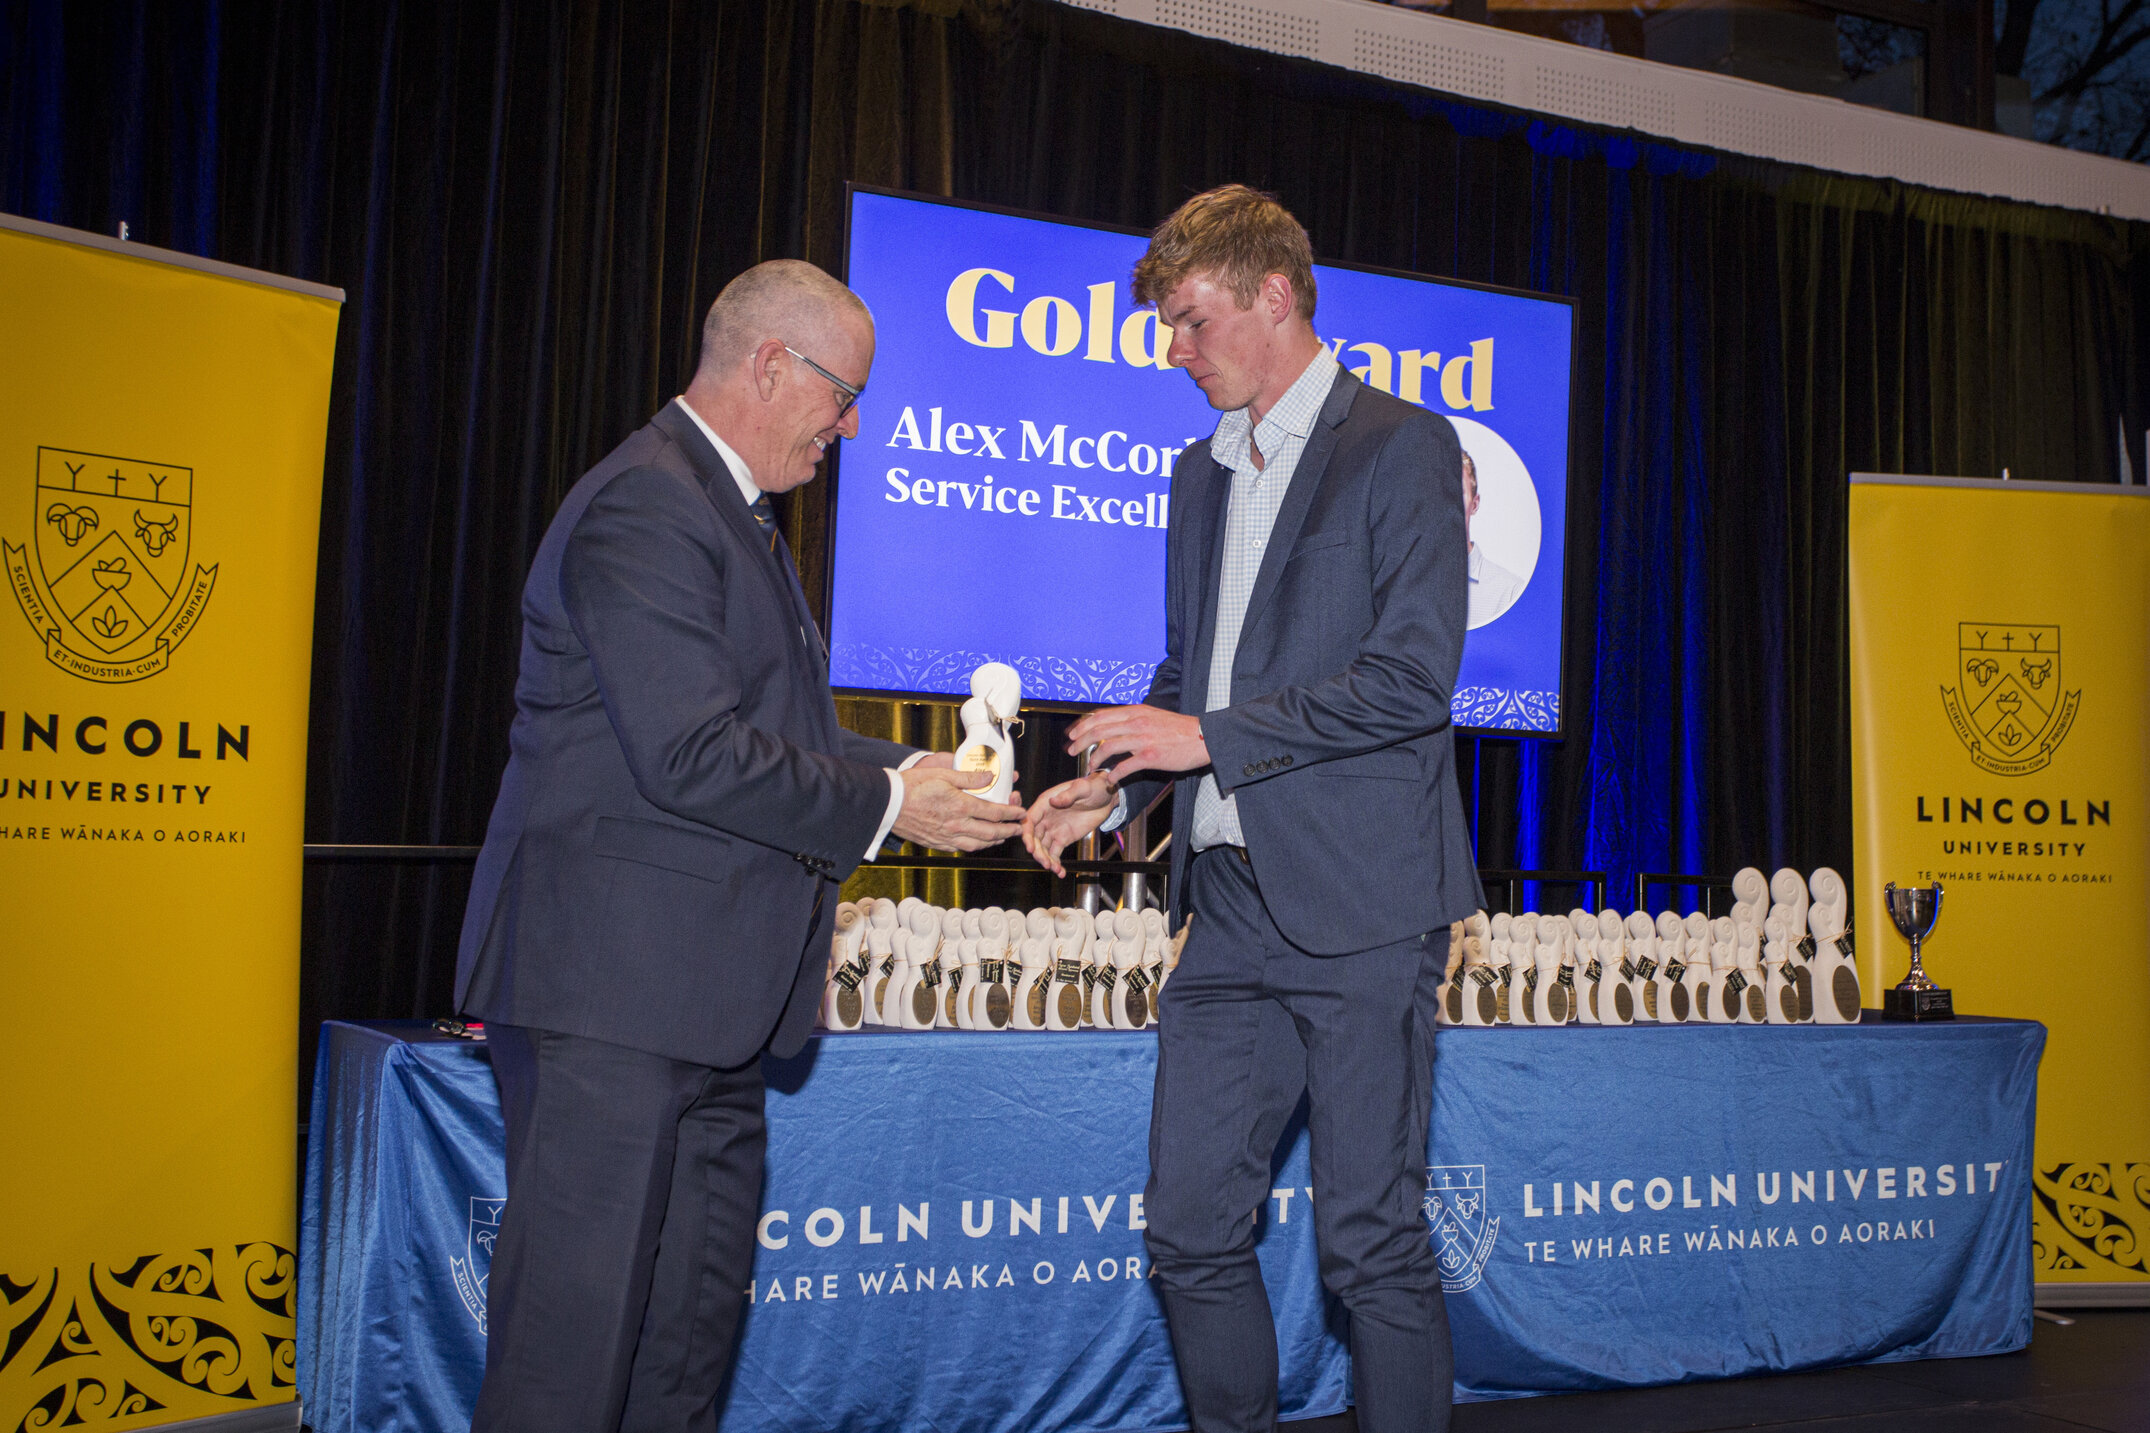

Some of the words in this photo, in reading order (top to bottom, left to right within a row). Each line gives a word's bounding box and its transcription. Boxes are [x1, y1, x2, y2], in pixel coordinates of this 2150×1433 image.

[945, 267, 1184, 371] Gold
[1317, 336, 1495, 412] ard
[885, 406, 1007, 461] Alex
[1017, 419, 1197, 479] McCor
[884, 467, 1041, 516] Service
[1050, 483, 1169, 529] Excell
[13, 565, 45, 625] SCIENTIA
[170, 580, 208, 637] PROBITATE
[0, 710, 250, 763] INCOLN
[0, 826, 51, 840] HARE
[153, 829, 166, 842] O
[174, 830, 246, 844] AORAKI
[1917, 796, 2111, 826] LINCOLN
[1943, 840, 2086, 857] UNIVERSITY
[1918, 871, 1932, 881] TE
[1938, 872, 1982, 882] WHARE
[2047, 873, 2057, 883] O
[2062, 873, 2113, 884] AORAKI
[1523, 1173, 1738, 1218] LINCOLN
[1757, 1160, 2009, 1205] UNIVERSIT
[756, 1202, 930, 1250] COLN
[1524, 1240, 1557, 1263] TE
[1571, 1233, 1671, 1260] WHARE
[1811, 1224, 1828, 1246] O
[1838, 1218, 1935, 1245] AORAKI
[457, 1272, 478, 1310] SCIENTIA
[1032, 1261, 1056, 1286] O
